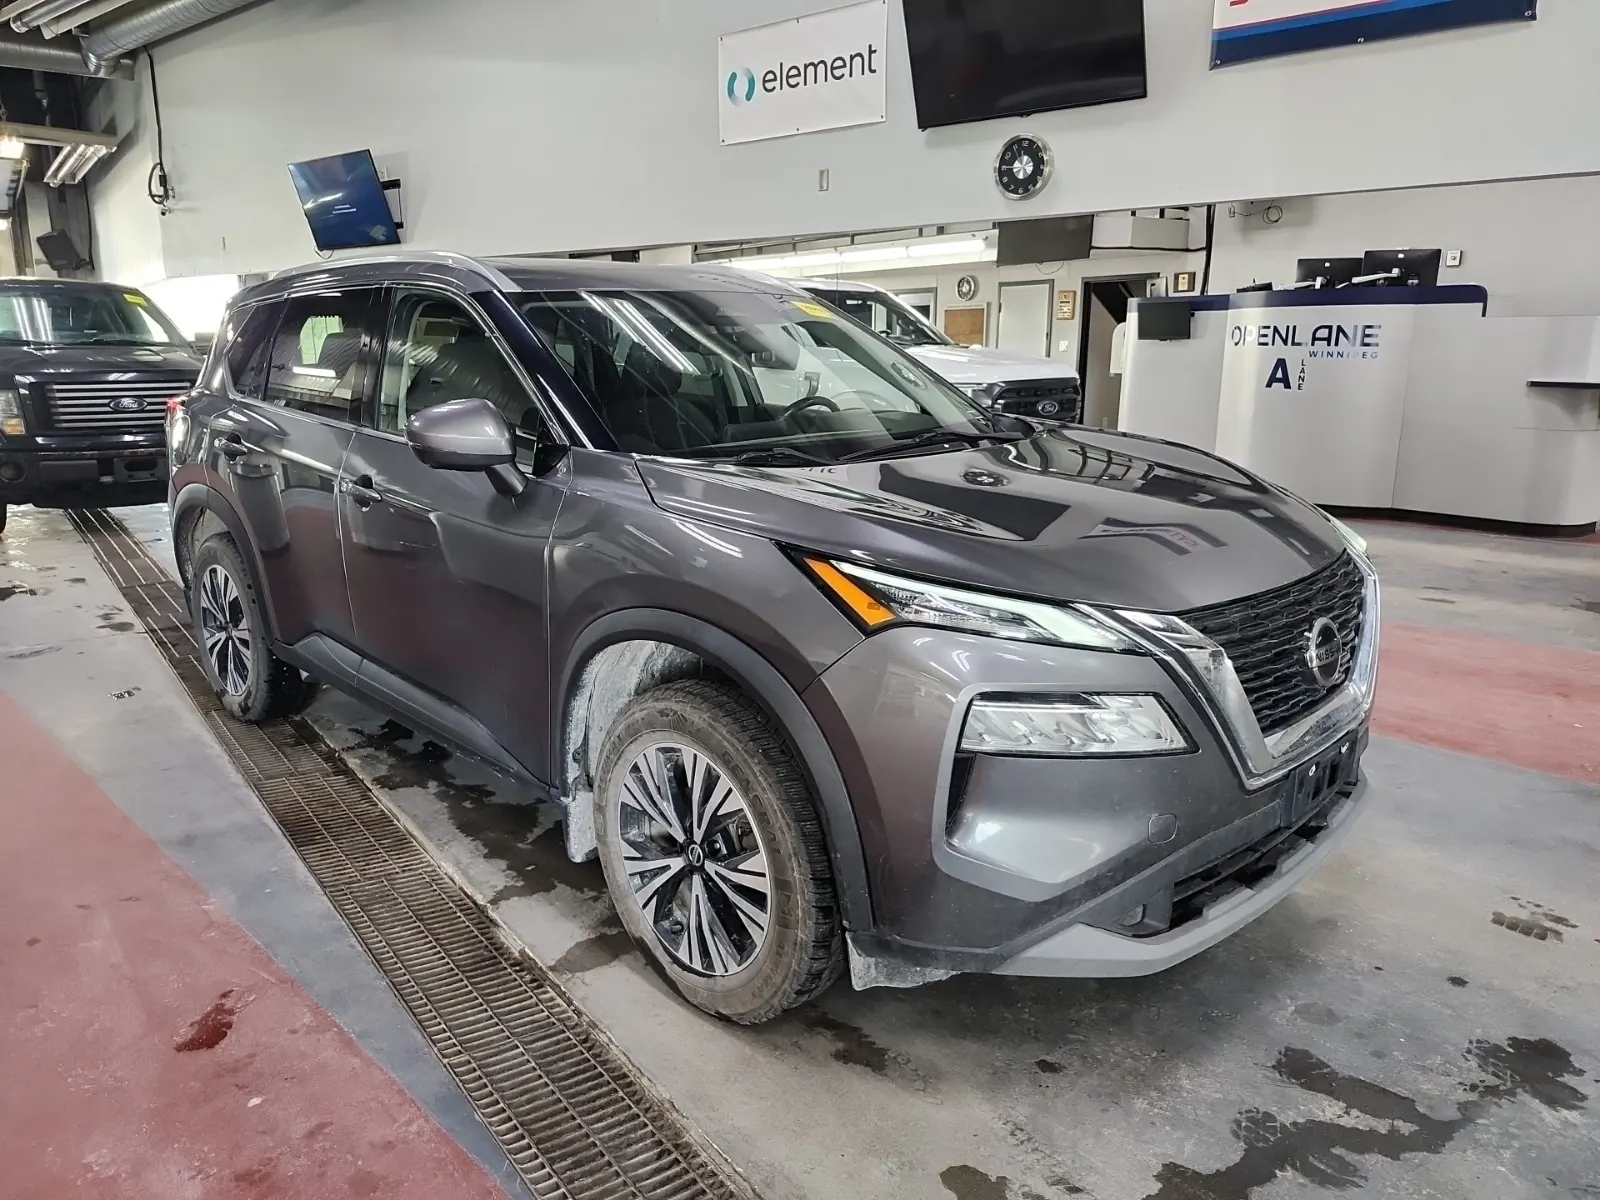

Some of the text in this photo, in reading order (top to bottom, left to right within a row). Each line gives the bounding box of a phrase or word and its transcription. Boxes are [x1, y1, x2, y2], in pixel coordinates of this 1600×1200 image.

[761, 43, 877, 94] element
[1231, 324, 1382, 347] OPENLANE
[1265, 357, 1307, 391] A LANE
